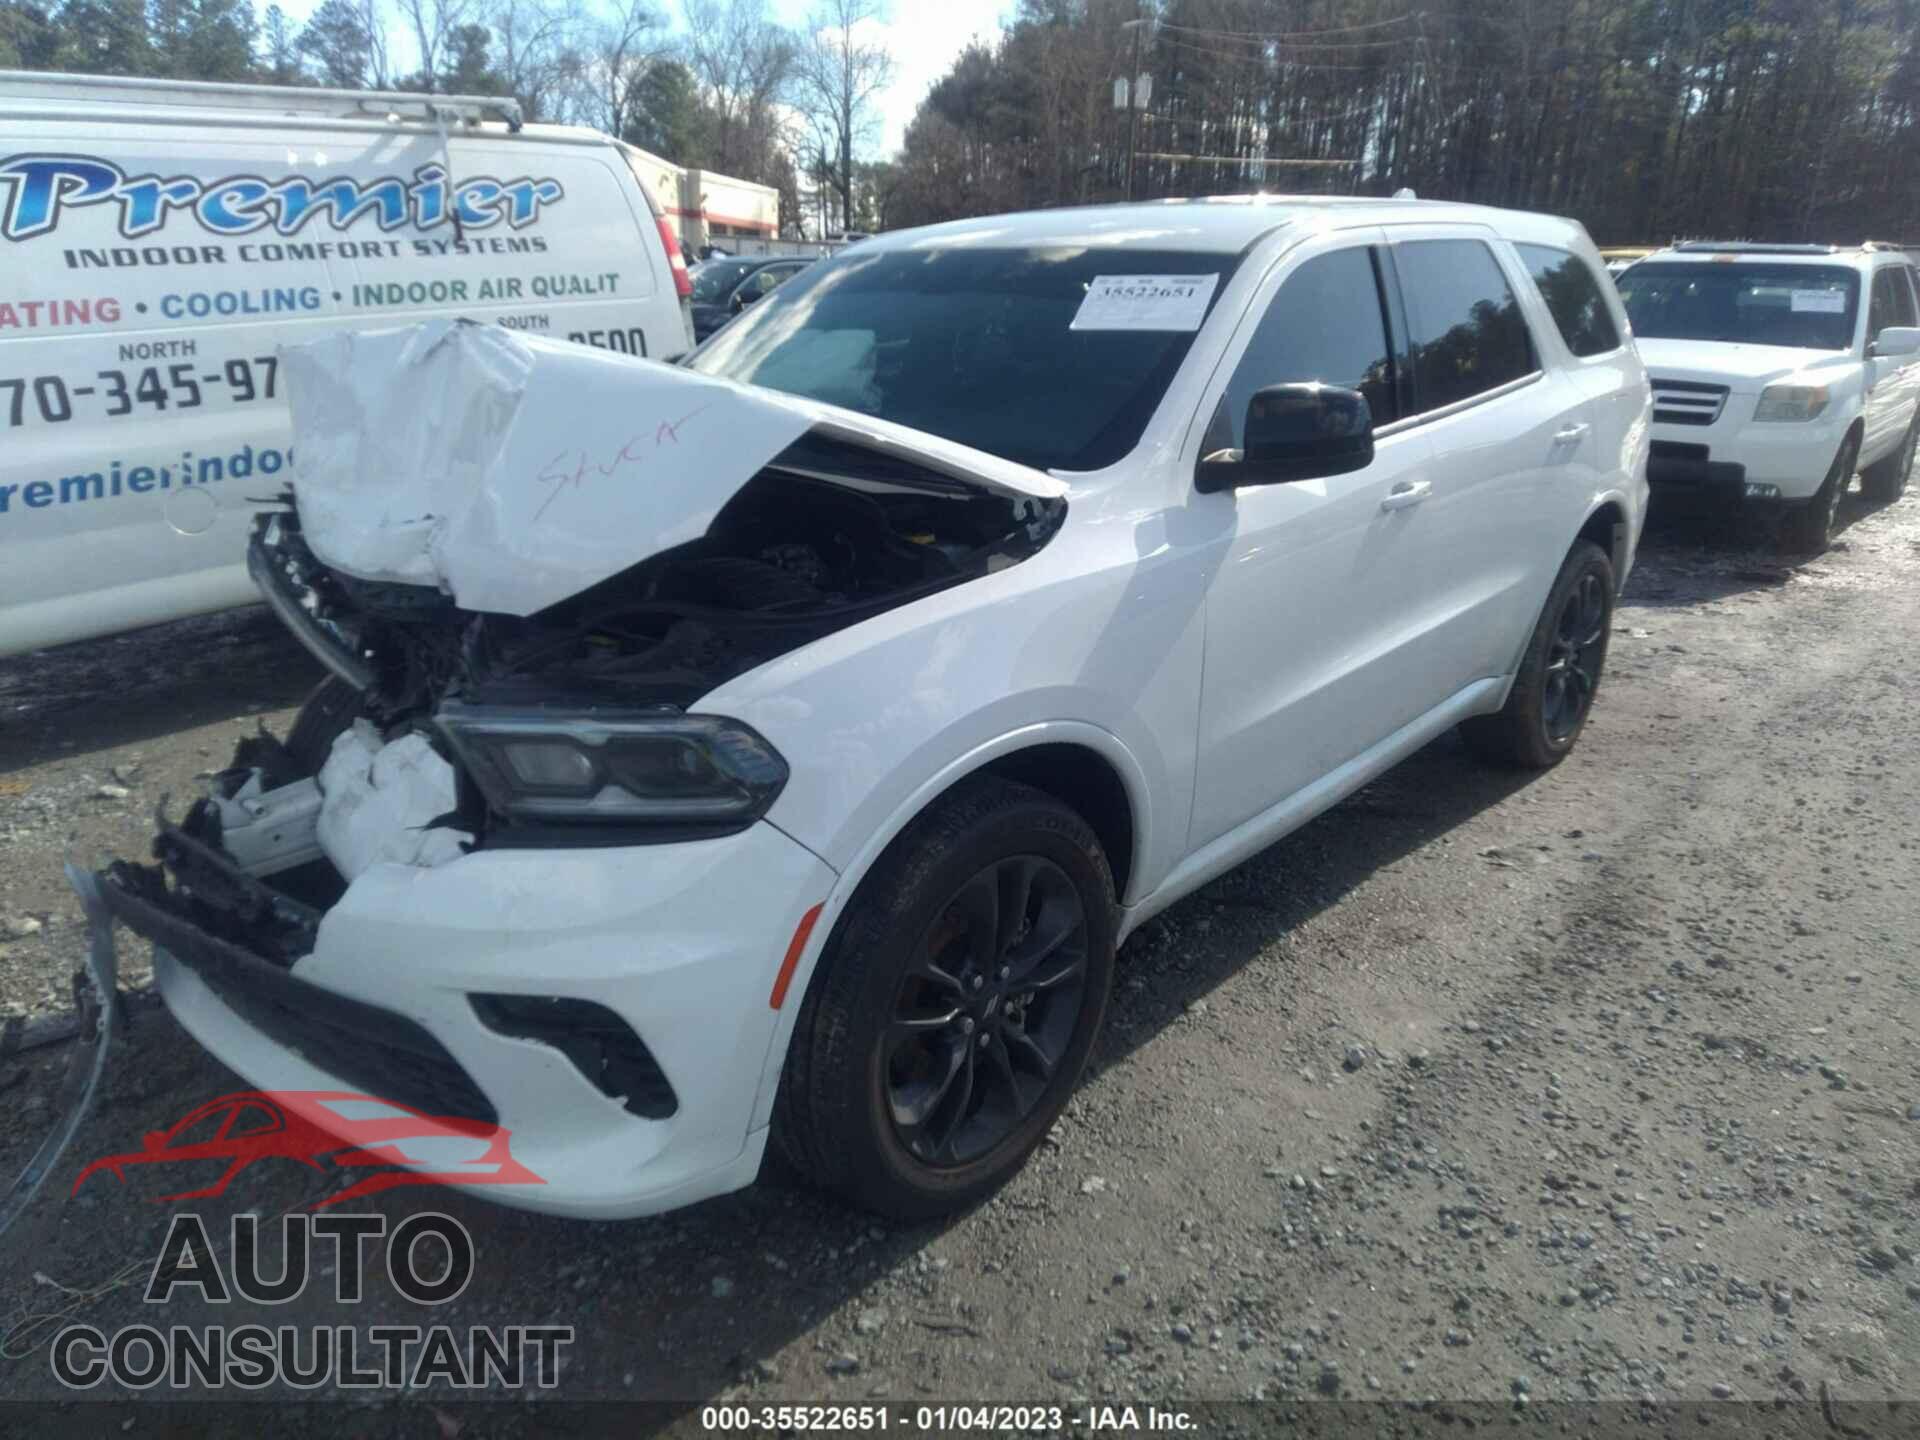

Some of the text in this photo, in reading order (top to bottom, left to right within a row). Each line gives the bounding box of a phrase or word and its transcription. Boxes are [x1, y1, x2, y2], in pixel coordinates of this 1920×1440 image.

[0, 152, 564, 242] Premier
[63, 235, 548, 269] INDOOR COMFORT SYSTEMS
[0, 273, 620, 329] ATING COOLING INDOOR AIR QUALIT
[119, 339, 197, 362] NORTH
[0, 444, 293, 513] remierindo
